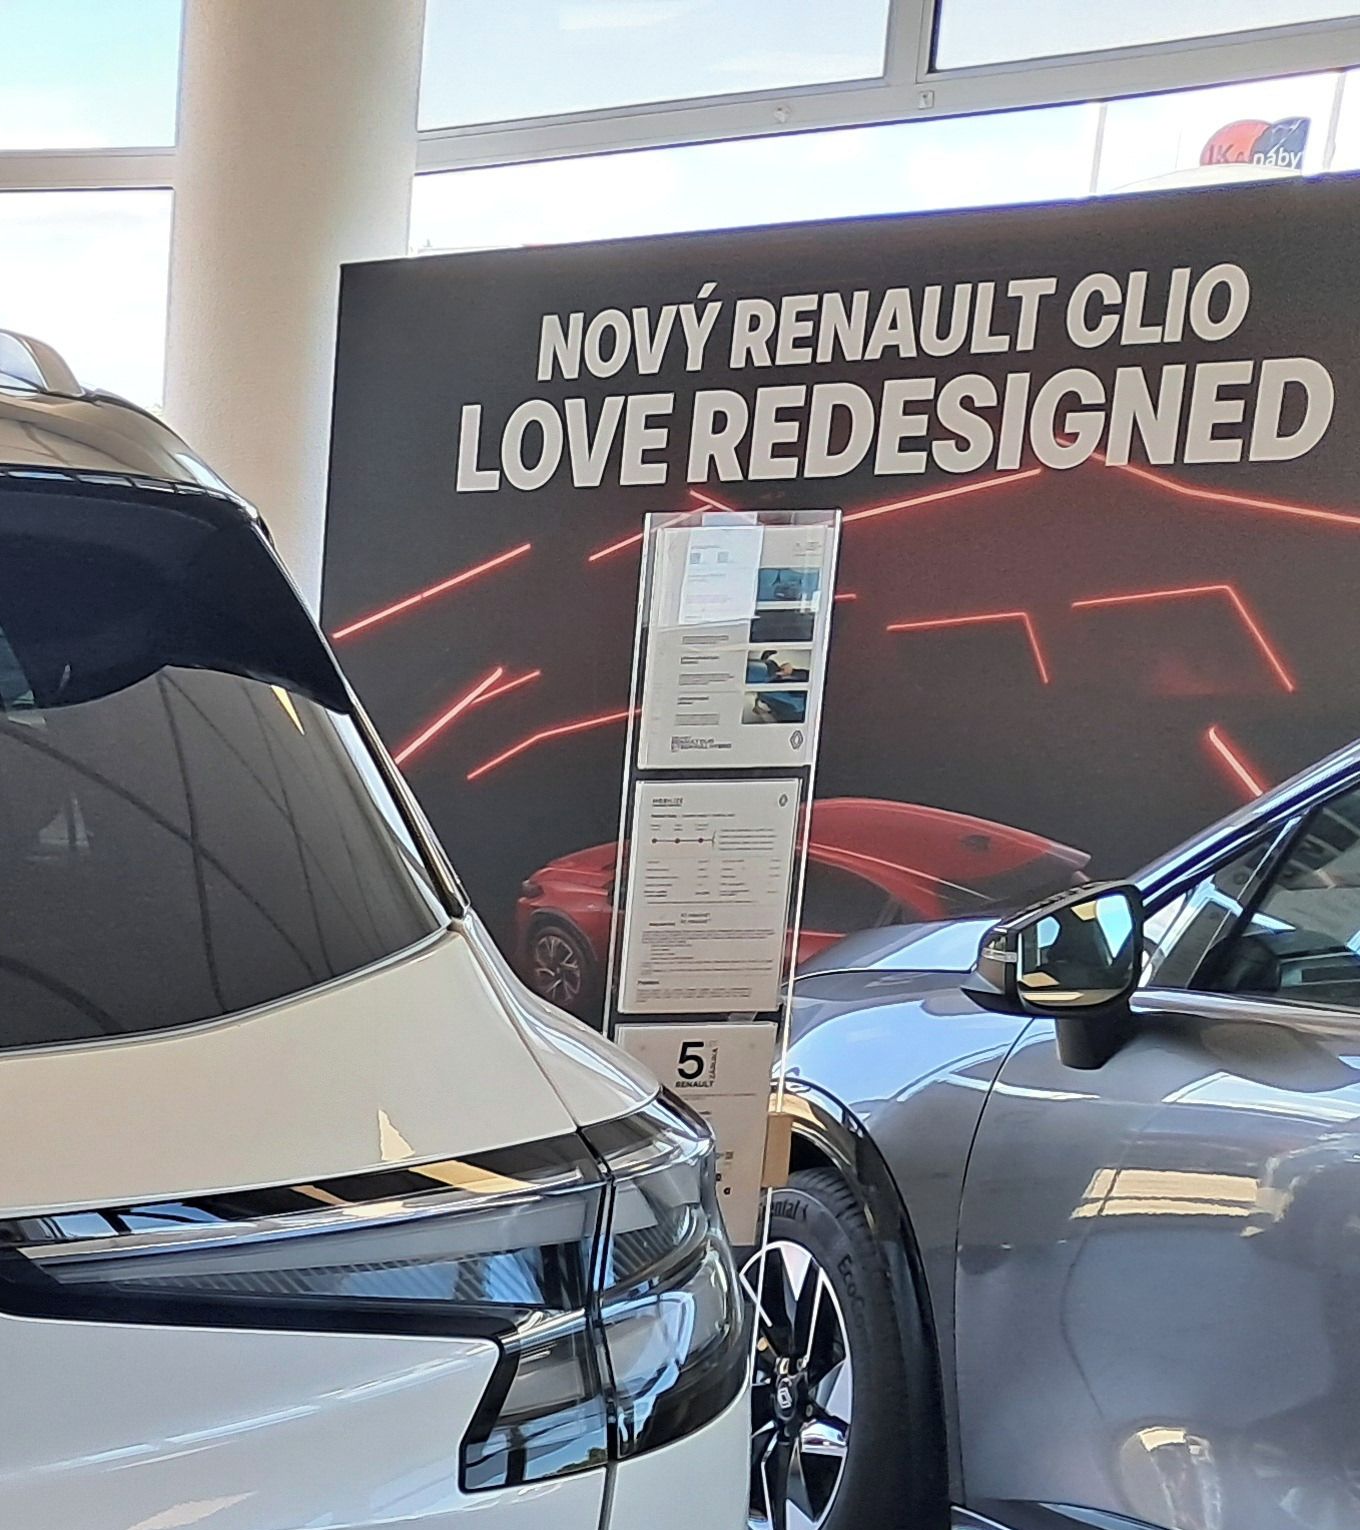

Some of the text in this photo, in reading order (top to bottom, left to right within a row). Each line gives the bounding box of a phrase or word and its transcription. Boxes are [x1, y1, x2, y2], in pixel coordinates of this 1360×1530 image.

[537, 263, 1250, 382] NOVÝ RENAULT CLIO
[456, 357, 1334, 492] LOVE REDESIGNED
[675, 1080, 714, 1088] RENAULT
[677, 1041, 704, 1080] 5
